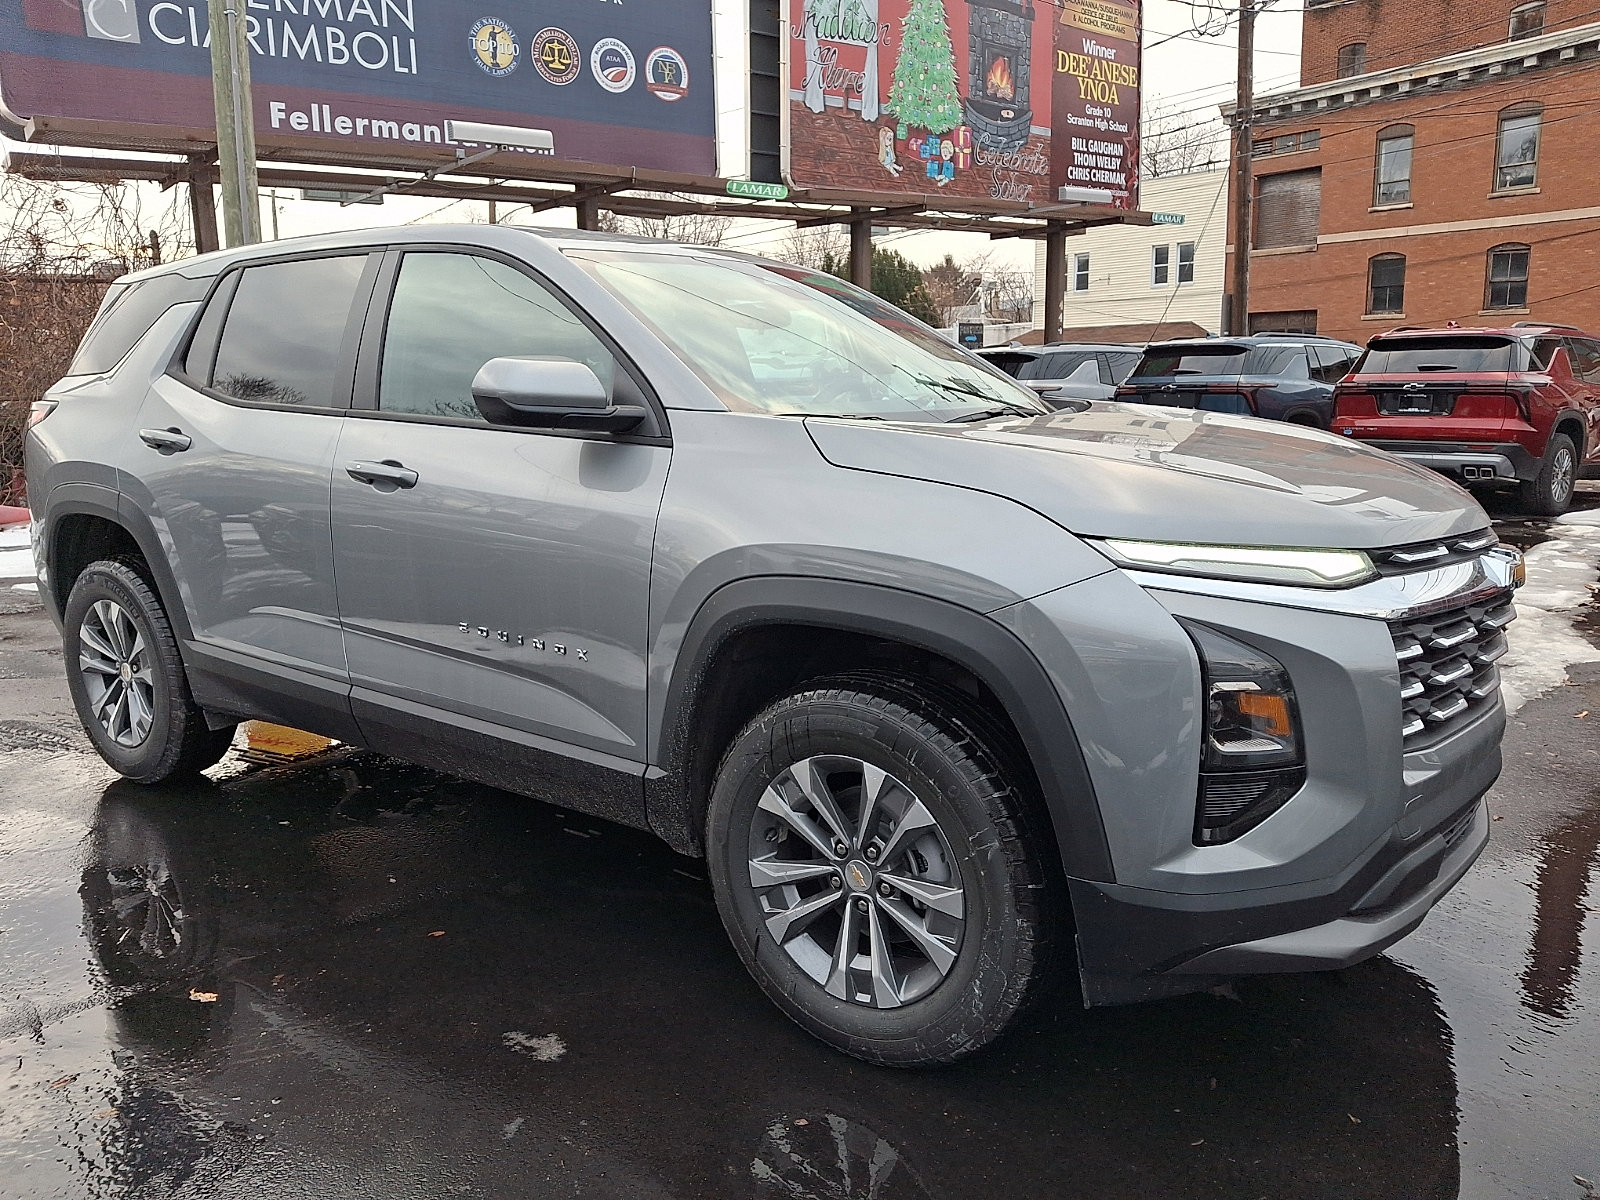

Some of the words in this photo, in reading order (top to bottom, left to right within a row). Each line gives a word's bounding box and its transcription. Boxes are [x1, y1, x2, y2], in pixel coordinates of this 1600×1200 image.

[470, 21, 482, 36] THE
[482, 18, 516, 39] NATIONAL
[1078, 16, 1099, 27] ALCOHOL
[1100, 20, 1126, 34] PROGRAMS
[149, 2, 417, 75] CIRIMBOLI
[469, 36, 497, 53] TOP
[499, 43, 520, 56] 100
[605, 55, 621, 63] ATAA
[1082, 38, 1117, 60] Winner
[474, 56, 491, 73] TRIAL
[492, 61, 517, 75] LAWYERS
[1077, 76, 1120, 105] YNOA
[1085, 104, 1104, 117] Grade
[1104, 107, 1112, 118] 10
[1067, 113, 1094, 127] Scranton
[1094, 118, 1108, 131] High
[1109, 121, 1129, 133] School
[1071, 137, 1088, 152] BILL
[1088, 139, 1124, 156] GAUGHAN
[1074, 152, 1096, 167] THOM
[1096, 156, 1122, 170] WELBY
[1067, 166, 1090, 181] CHRIS
[1091, 168, 1126, 186] CHERMAK
[731, 182, 782, 197] LAMAR
[459, 621, 589, 662] EQUINOX
